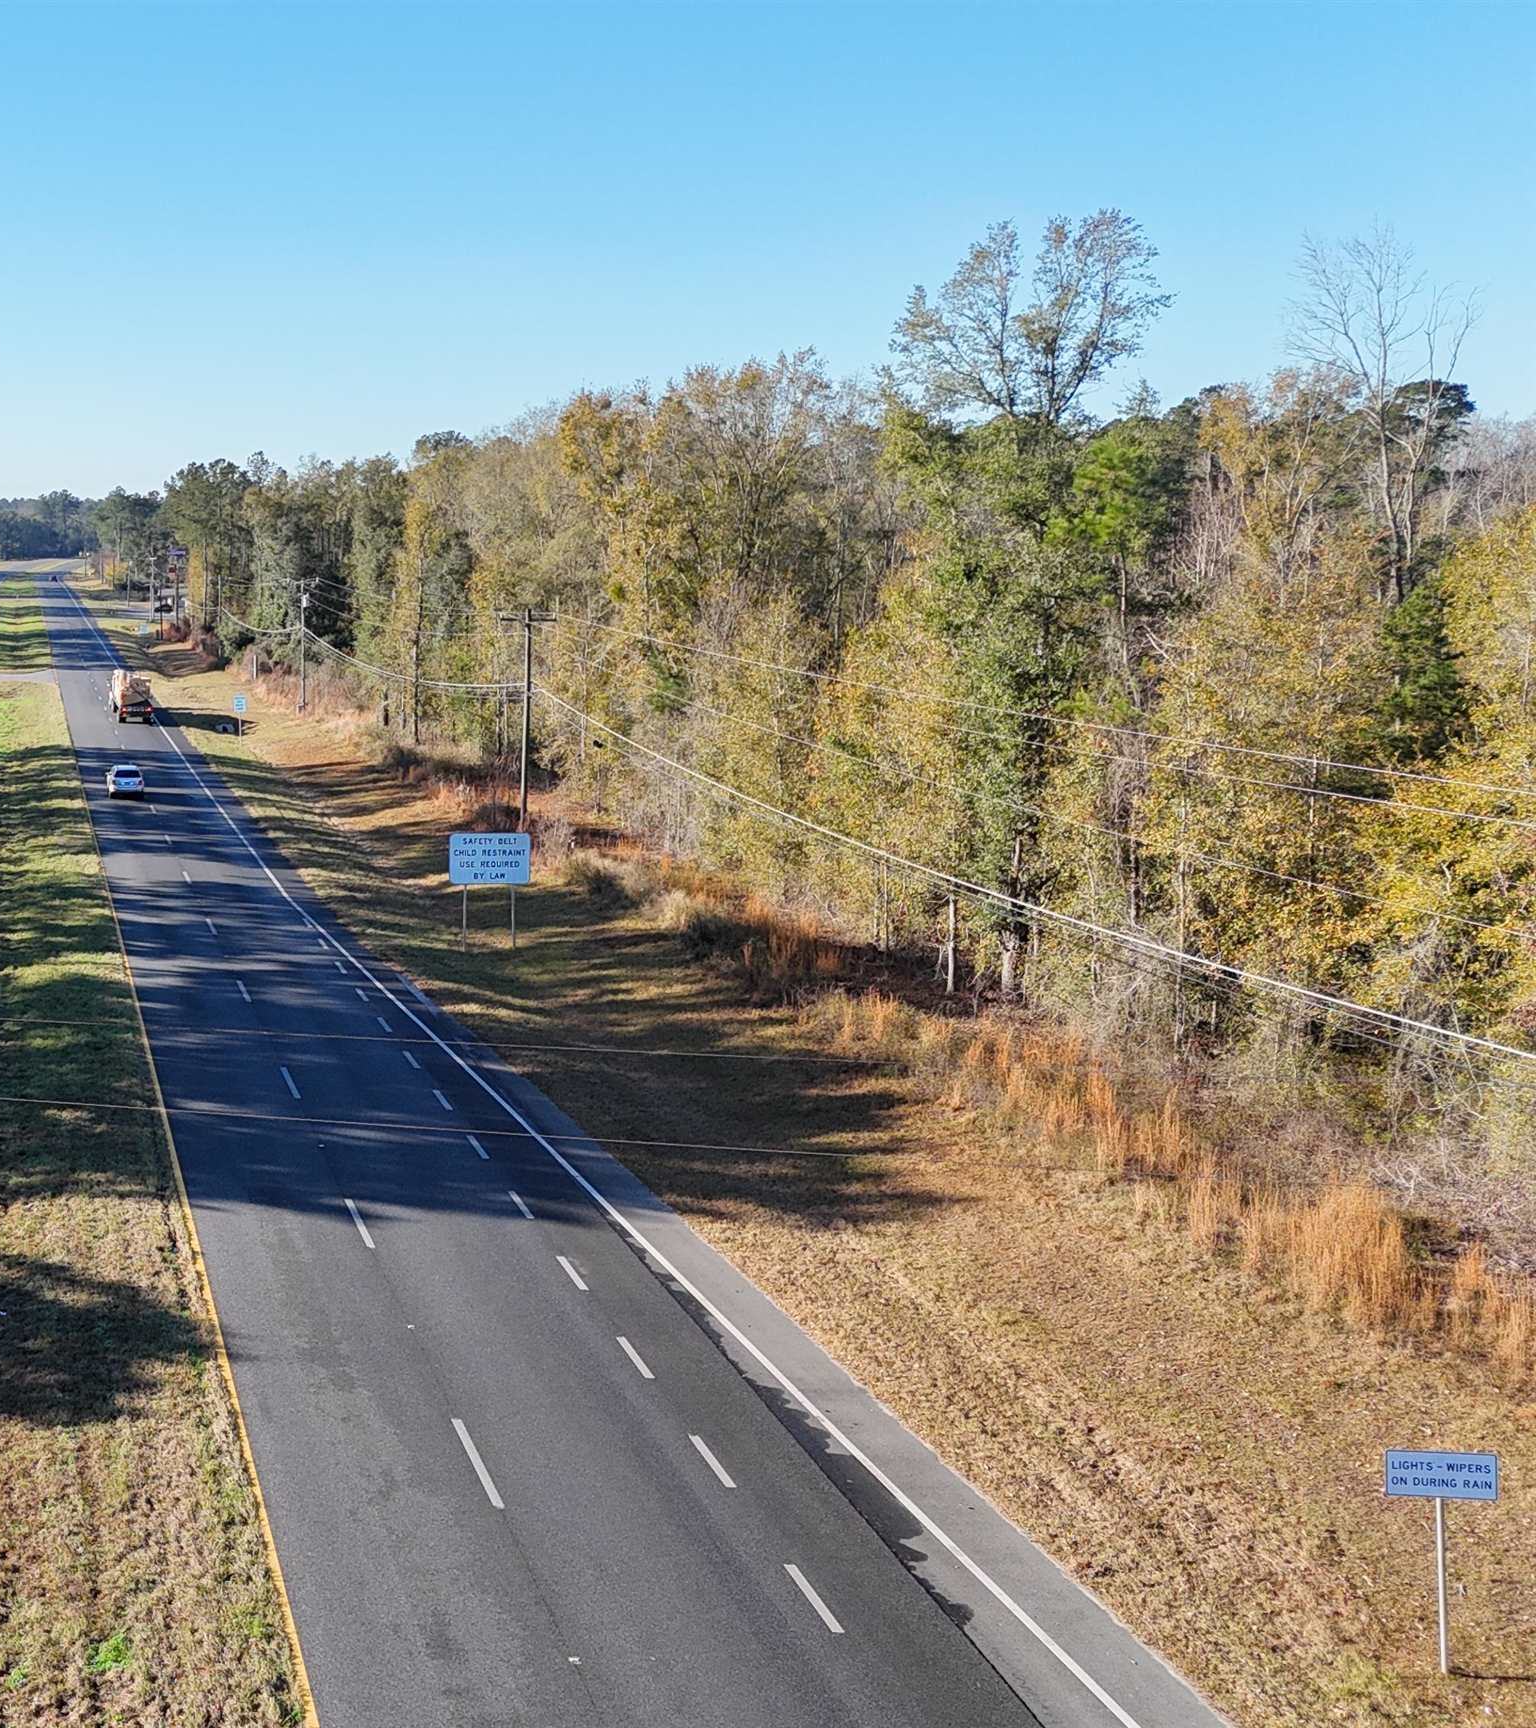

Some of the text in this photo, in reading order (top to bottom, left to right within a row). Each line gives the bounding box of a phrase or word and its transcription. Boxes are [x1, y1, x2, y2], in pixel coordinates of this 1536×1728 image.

[463, 837, 517, 845] SAFETY BELT
[473, 872, 506, 880] BY LAW
[1391, 1460, 1433, 1471] LIGHTS
[1446, 1463, 1491, 1474] WIPERS
[1391, 1476, 1493, 1490] ON DURING RAIN
